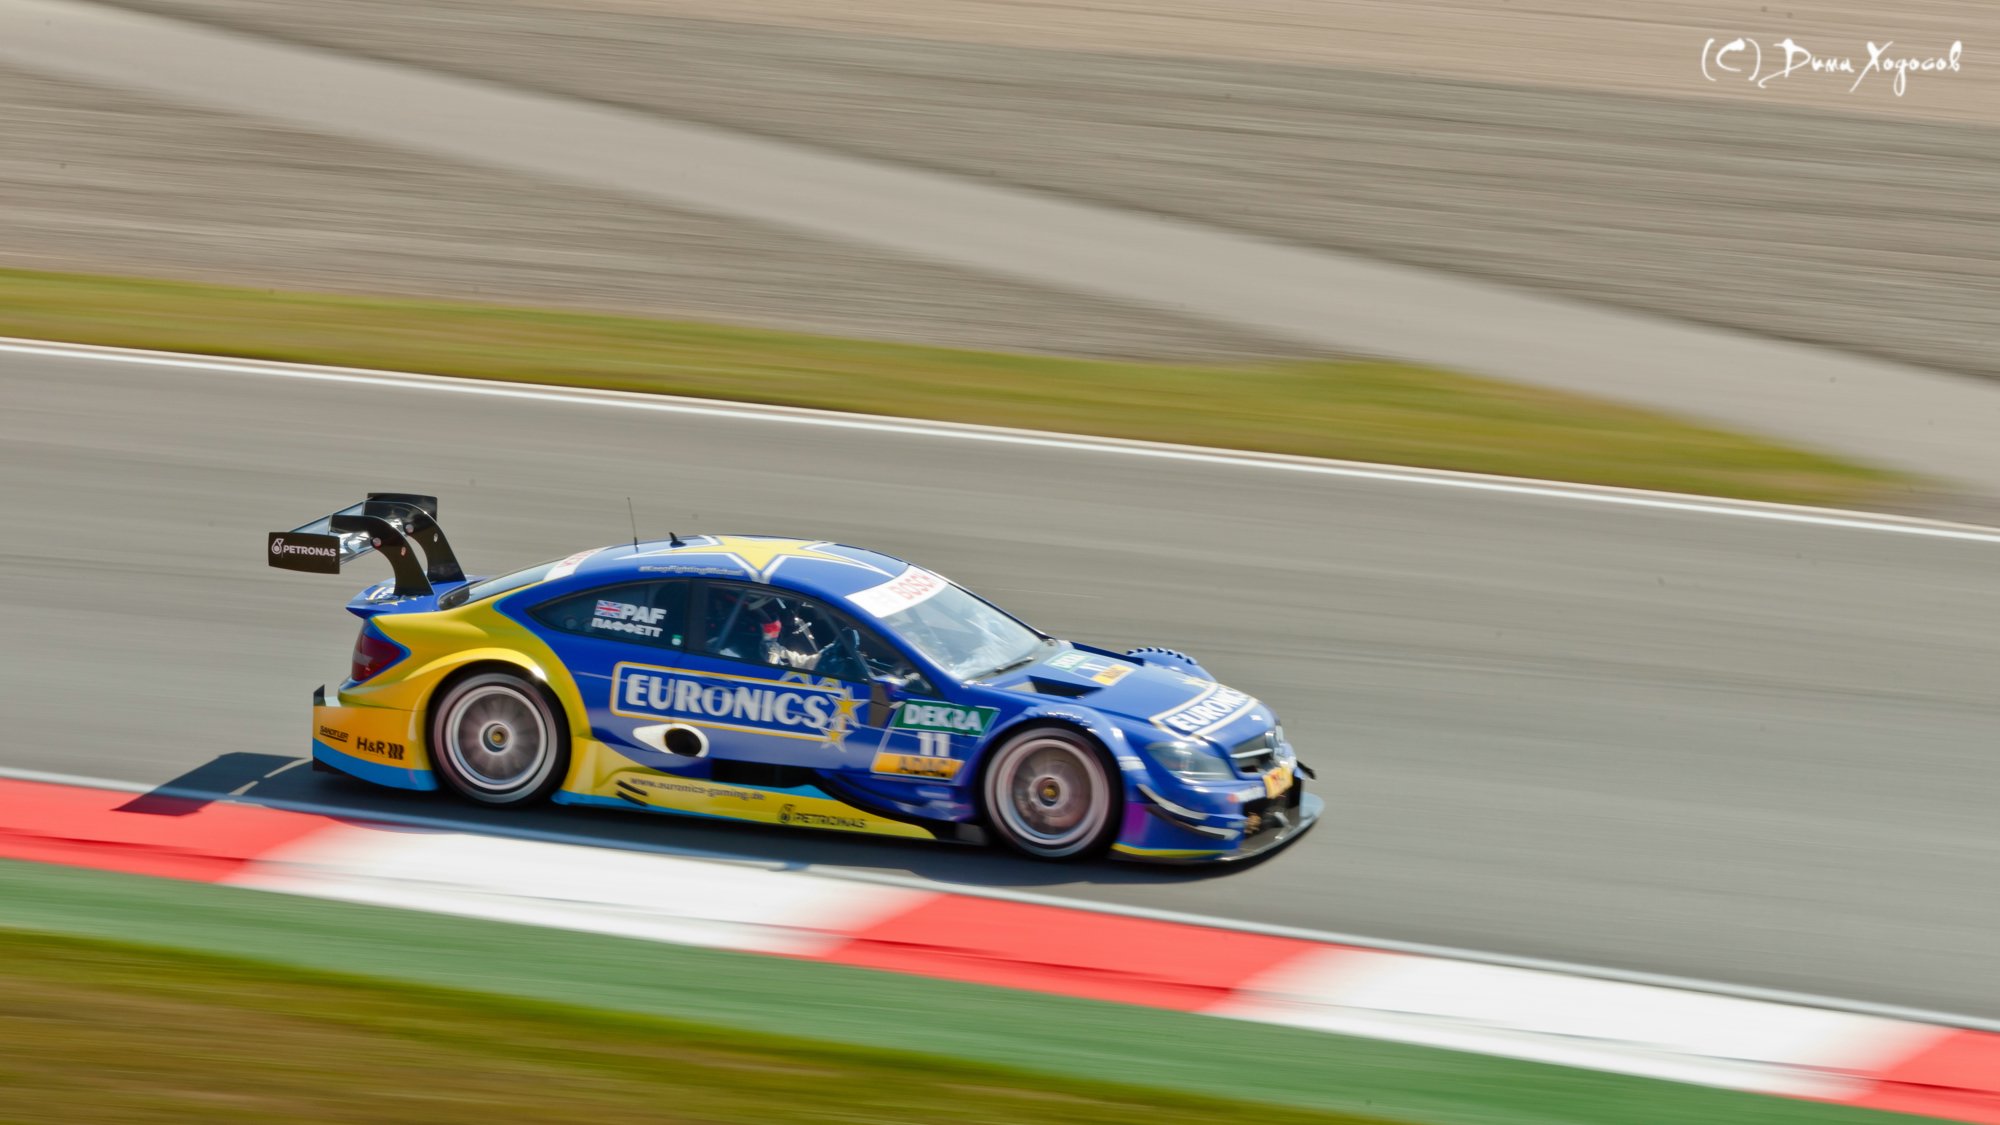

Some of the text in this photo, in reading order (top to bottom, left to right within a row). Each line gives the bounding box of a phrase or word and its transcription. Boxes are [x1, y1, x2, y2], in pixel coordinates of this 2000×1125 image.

[283, 544, 337, 557] PETRONAS
[889, 572, 937, 601] BOSCH
[619, 603, 667, 625] PAF
[625, 673, 829, 729] EURONICS
[903, 703, 983, 732] DEKRA
[356, 736, 386, 755] H&R
[917, 731, 951, 757] 11
[794, 812, 867, 829] PETRONAS
